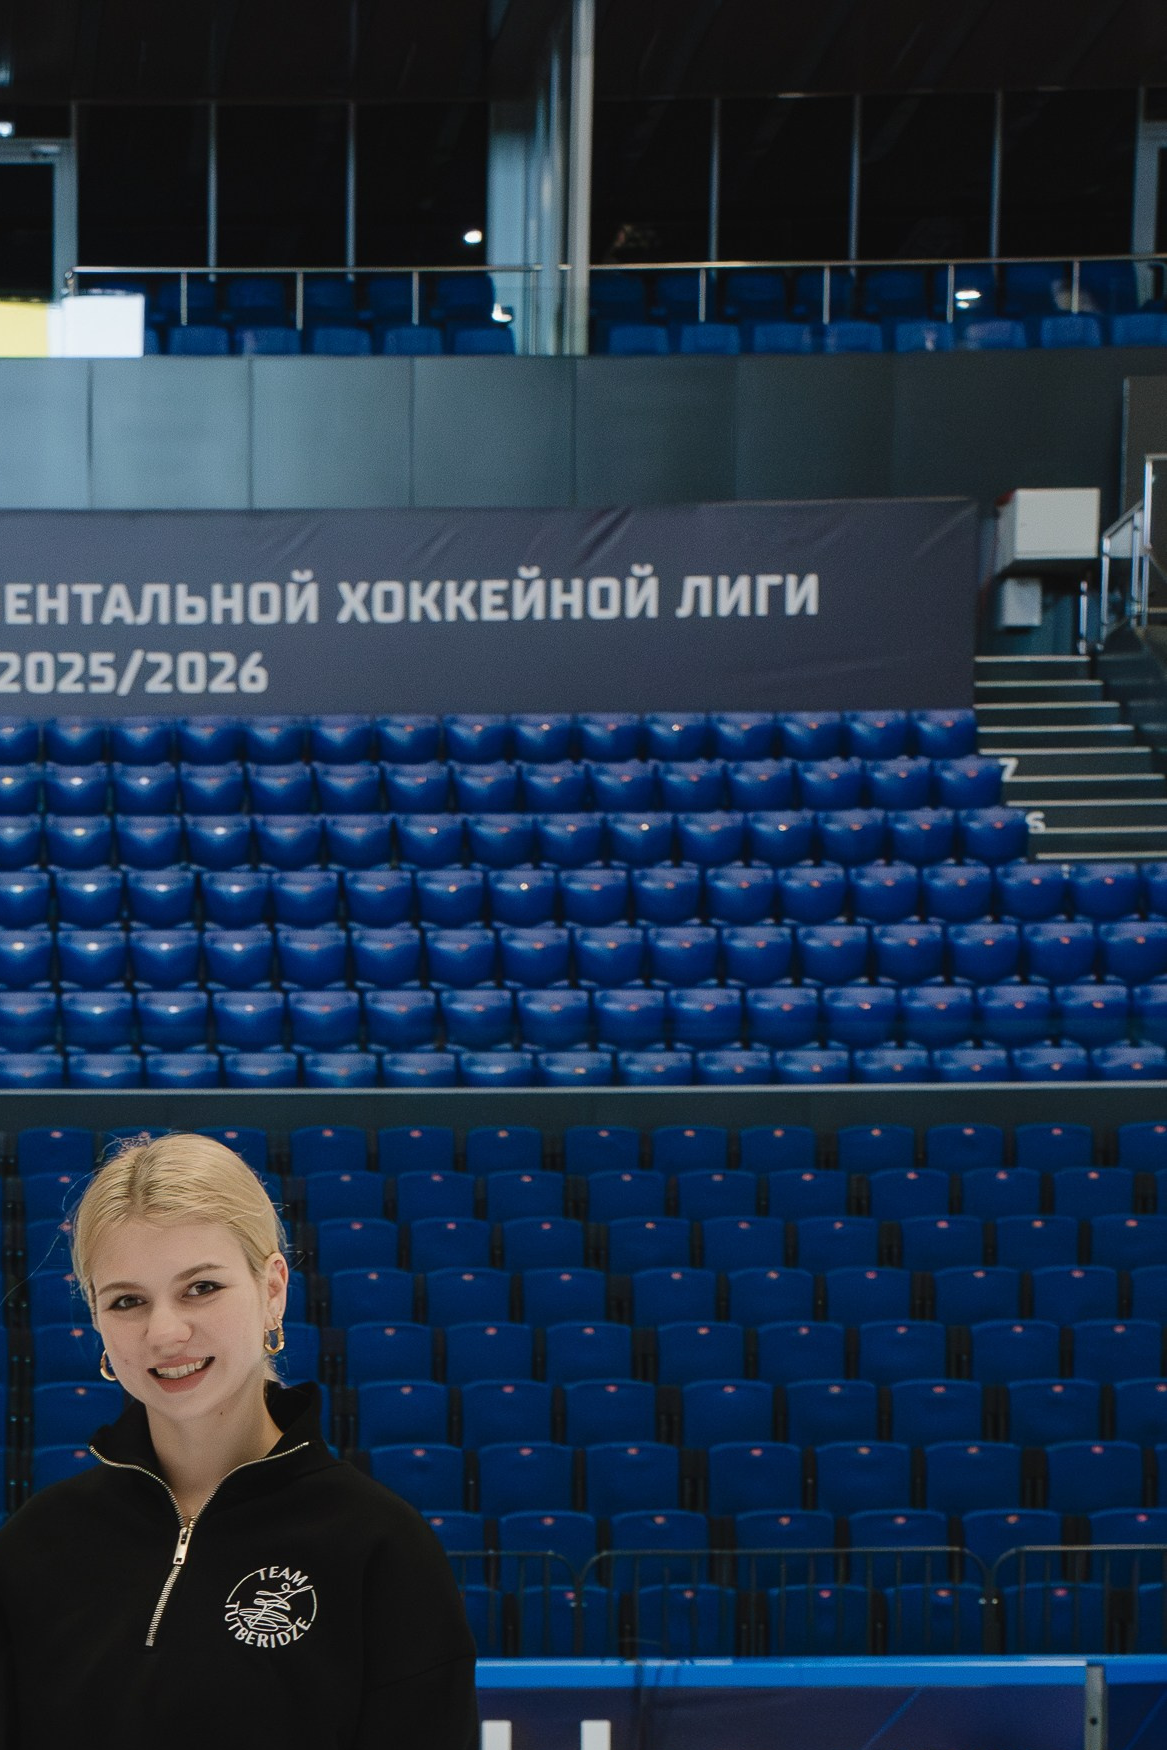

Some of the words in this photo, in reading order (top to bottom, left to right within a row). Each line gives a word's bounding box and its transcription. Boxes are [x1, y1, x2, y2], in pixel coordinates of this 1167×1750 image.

[336, 564, 658, 624] ХОККЕЙНОЙ
[676, 574, 819, 618] ЛИГИ
[258, 1566, 309, 1587] TEAM
[225, 1600, 312, 1648] TUTBERIDZE
